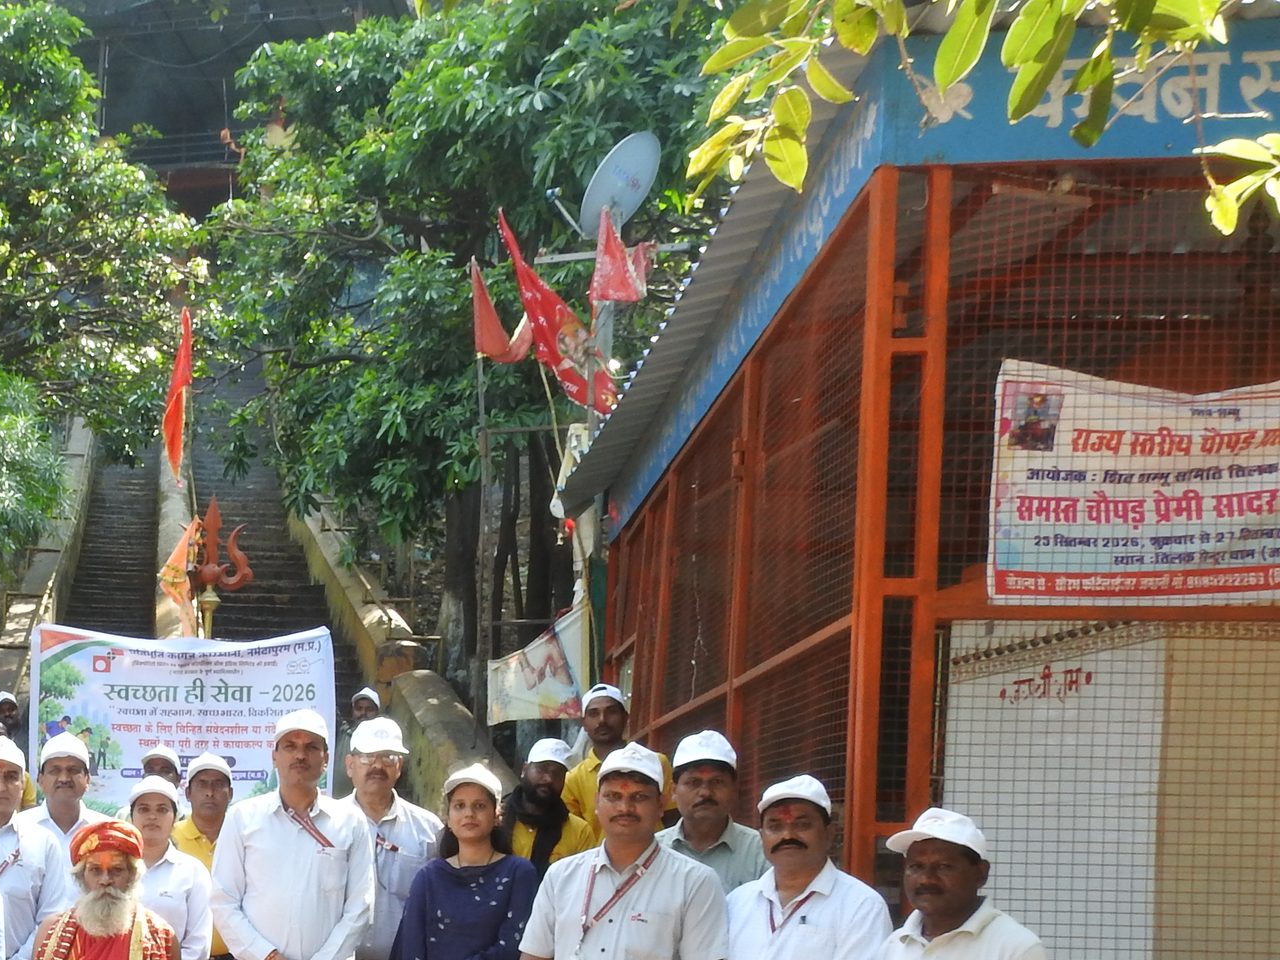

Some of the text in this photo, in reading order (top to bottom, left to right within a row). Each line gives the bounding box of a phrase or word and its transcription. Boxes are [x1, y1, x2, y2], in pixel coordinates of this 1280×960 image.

[1071, 428, 1126, 455] राज्य
[1129, 426, 1193, 457] स्तरीय
[1027, 465, 1087, 483] आयोजक
[1175, 465, 1223, 483] समिति
[1016, 488, 1280, 530] समस्त चौपड़ प्रेमी सादर
[103, 683, 179, 703] स्वच्छता
[184, 677, 206, 704] ही
[210, 678, 254, 703] सेवा
[111, 723, 141, 733] स्वच्छता
[145, 721, 153, 733] के
[156, 721, 173, 736] लिए
